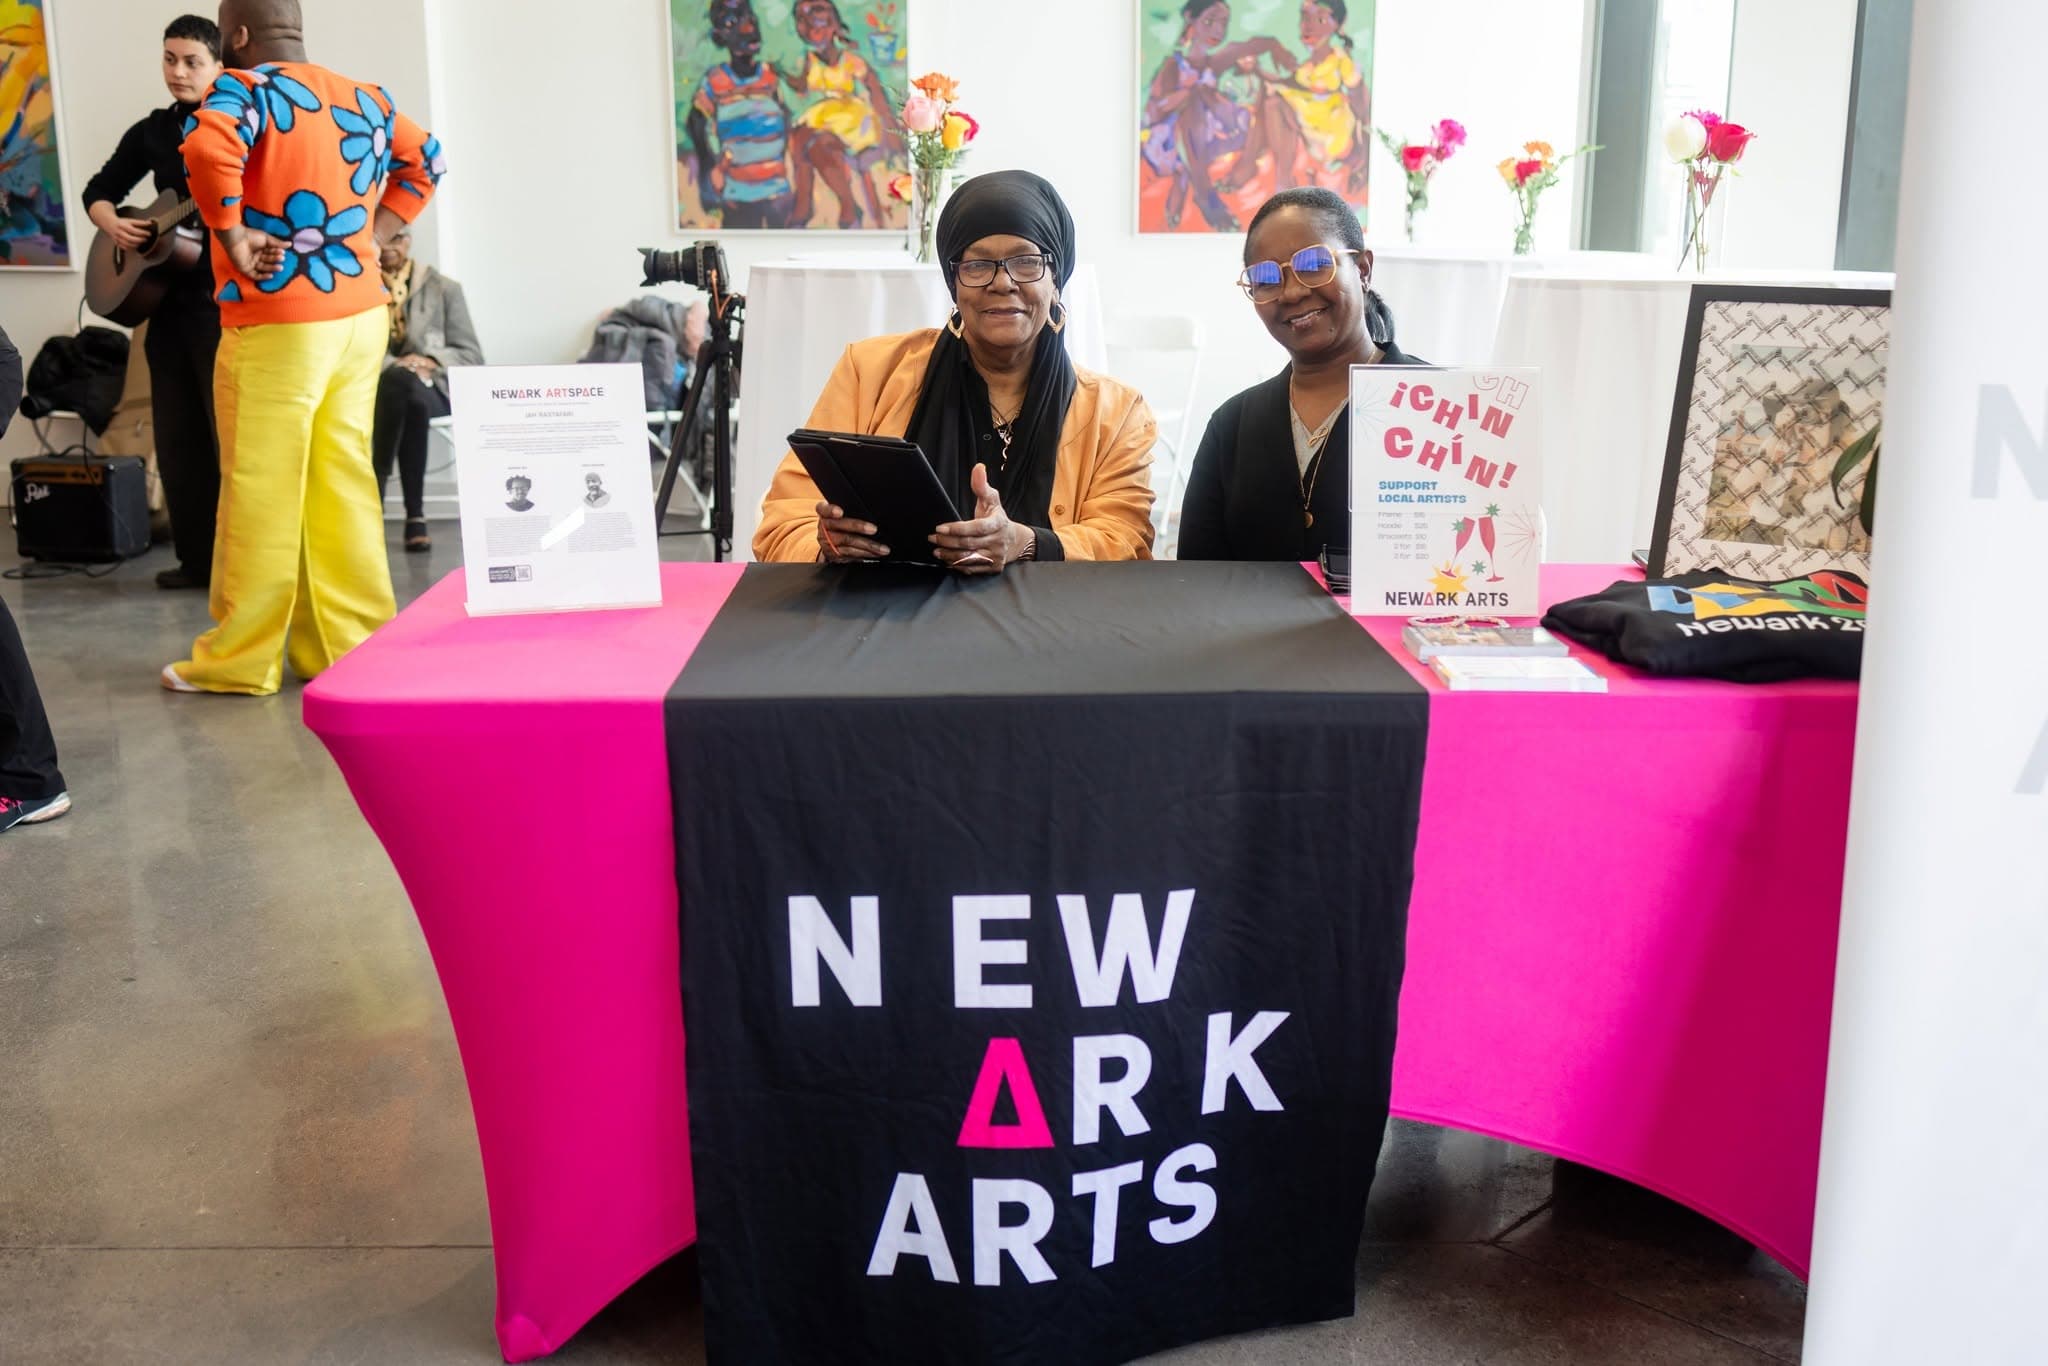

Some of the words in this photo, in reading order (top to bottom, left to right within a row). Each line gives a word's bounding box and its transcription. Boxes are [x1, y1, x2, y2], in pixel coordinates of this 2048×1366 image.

[491, 388, 541, 400] NEWARK
[546, 386, 605, 398] ARTSPACE
[1383, 426, 1518, 489] CHÍN!
[1378, 480, 1438, 491] SUPPORT
[1378, 494, 1415, 504] LOCAL
[1417, 494, 1467, 504] ARTISTS
[1385, 591, 1458, 606] NEWARK
[1465, 592, 1509, 607] ARTS
[1675, 613, 1830, 637] Newark
[866, 1142, 1217, 1286] ARTS
